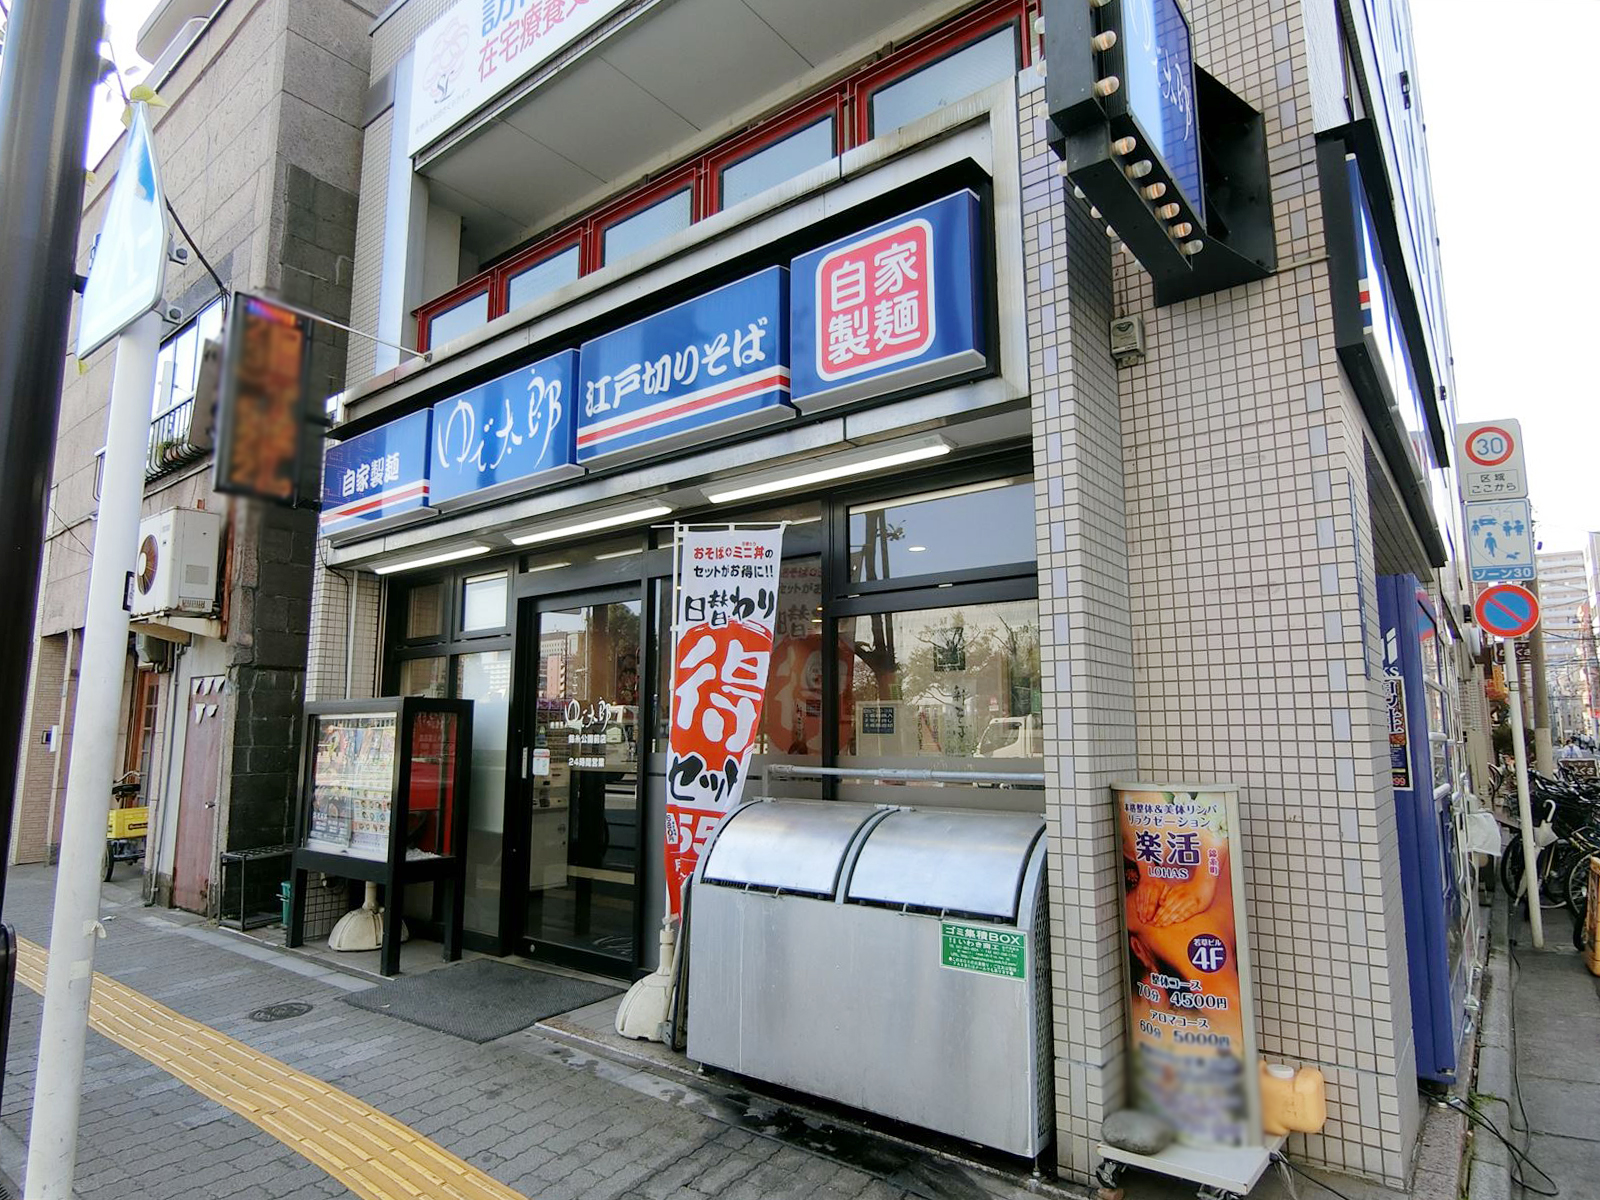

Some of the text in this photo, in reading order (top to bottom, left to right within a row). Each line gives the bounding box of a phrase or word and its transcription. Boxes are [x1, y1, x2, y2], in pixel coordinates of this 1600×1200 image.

[482, 0, 526, 37] 訪
[585, 316, 768, 417] 江戸切りそば
[438, 369, 562, 475] ゆで太郎
[1476, 437, 1504, 456] 30
[342, 453, 400, 497] 自家製麺
[1472, 482, 1516, 493] ここから
[693, 564, 774, 579] セットがお得に!!
[685, 586, 775, 627] 日替わり
[675, 634, 771, 752] 得
[1128, 814, 1211, 828] リラクゼーション
[1136, 831, 1200, 864] 楽活
[1148, 866, 1188, 878] LOHAS
[945, 926, 1020, 945] ゴミ集積BOX
[1192, 947, 1224, 970] 4F
[1170, 992, 1227, 1009] 4500円
[1150, 1010, 1209, 1028] アロマコース
